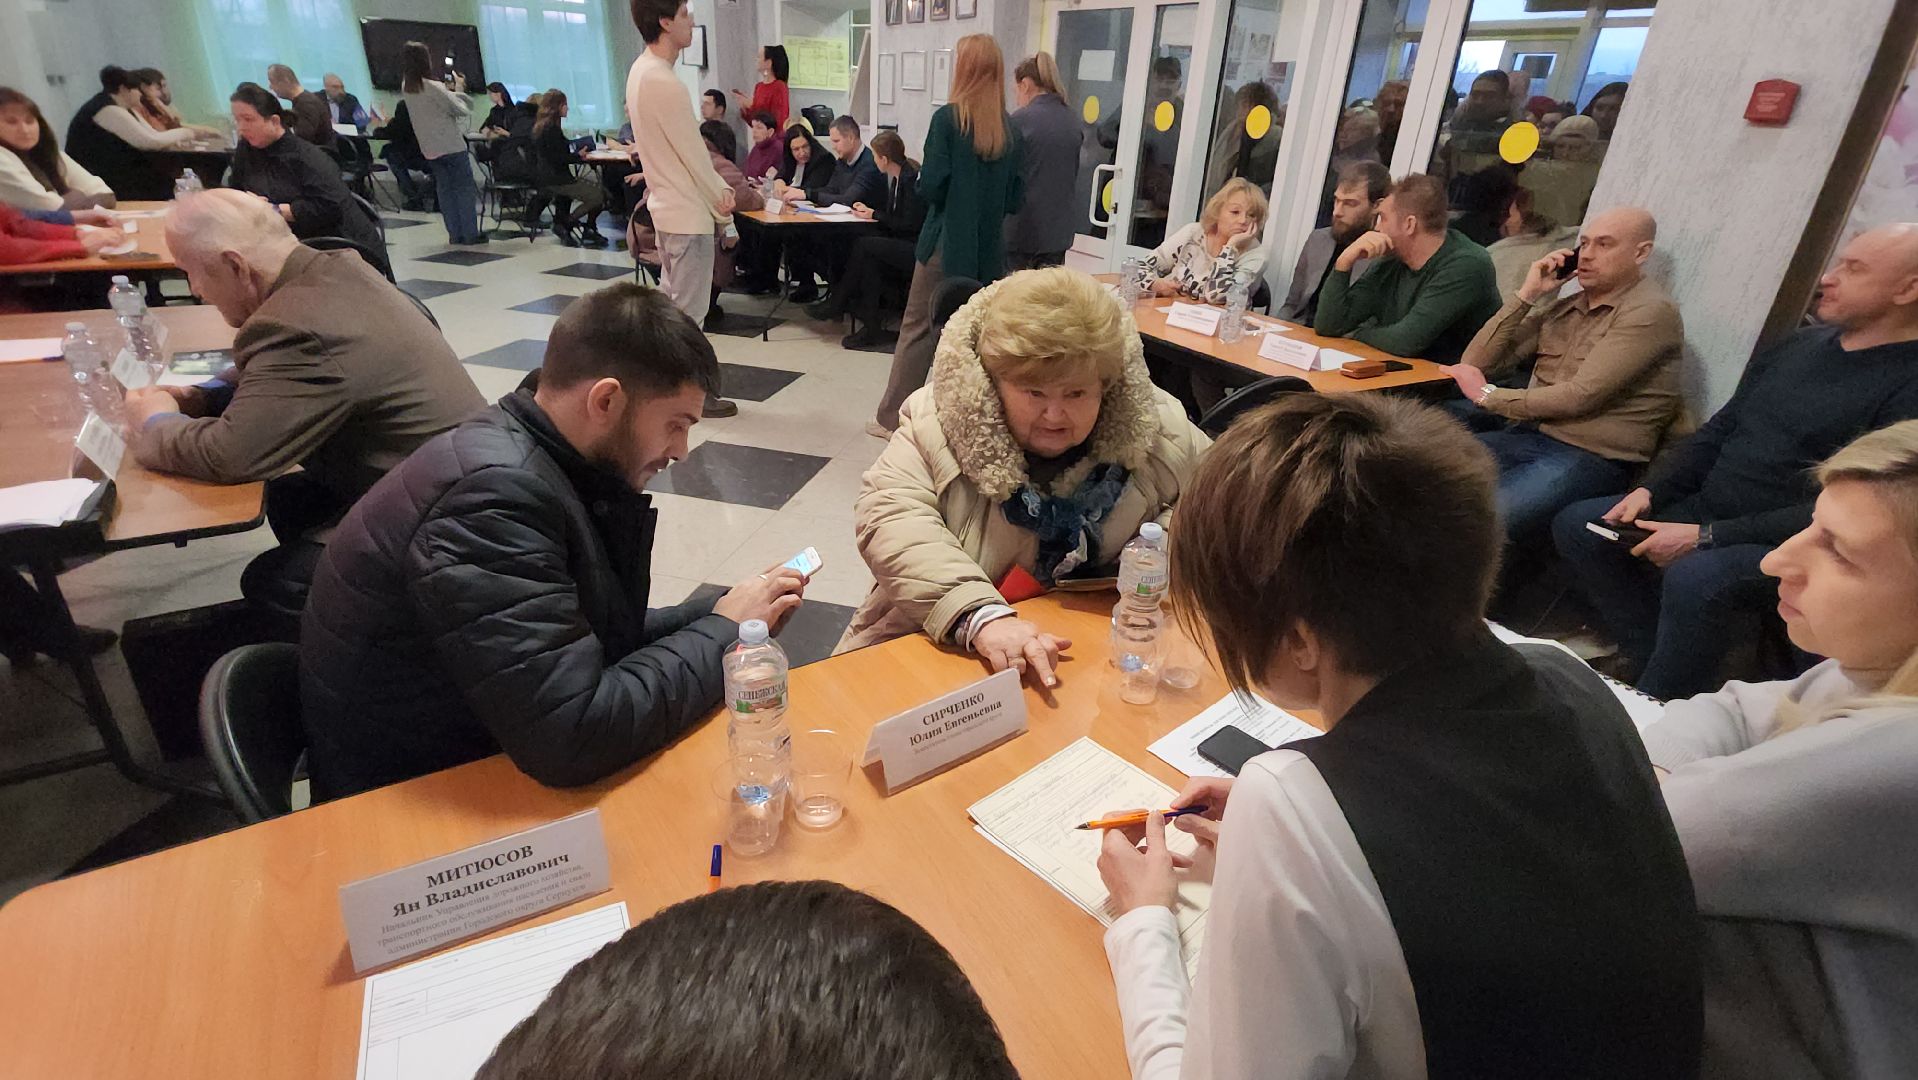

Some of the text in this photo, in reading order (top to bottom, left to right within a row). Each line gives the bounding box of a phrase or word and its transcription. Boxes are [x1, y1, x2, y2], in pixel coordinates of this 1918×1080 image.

[909, 726, 943, 747] Юлия
[944, 700, 1003, 732] Евгеньевна
[922, 692, 985, 726] СИРЧЕНКО
[392, 853, 569, 918] Ян Владиславович
[426, 845, 533, 888] МИТЮСОВ
[377, 919, 448, 947] транспортного
[381, 913, 434, 934] Начальник
[436, 894, 490, 917] Управления
